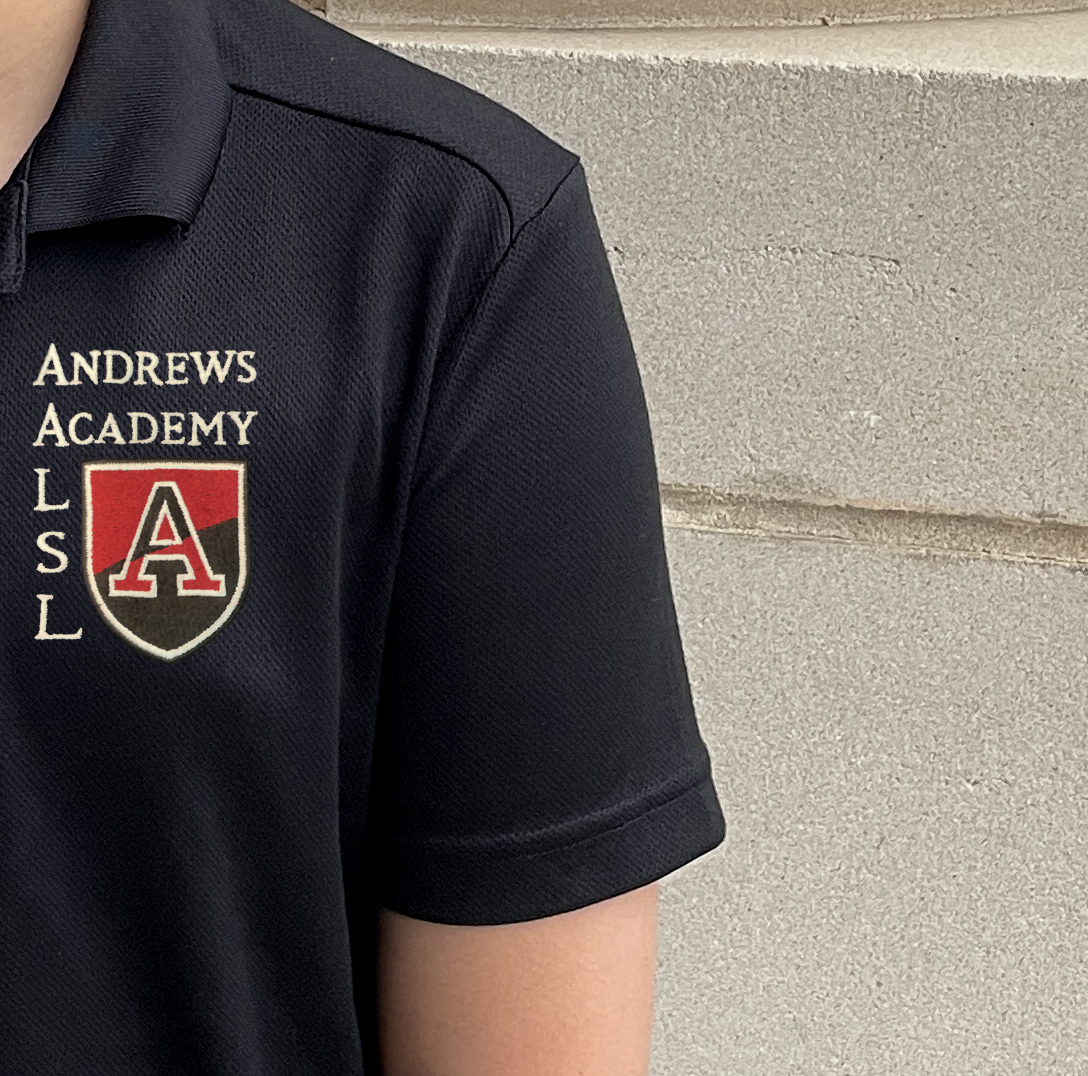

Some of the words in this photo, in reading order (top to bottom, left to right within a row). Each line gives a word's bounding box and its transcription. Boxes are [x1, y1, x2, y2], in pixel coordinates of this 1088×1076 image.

[32, 342, 257, 386] ANDREWS
[32, 402, 259, 447] ACADEMY
[108, 480, 227, 597] A
